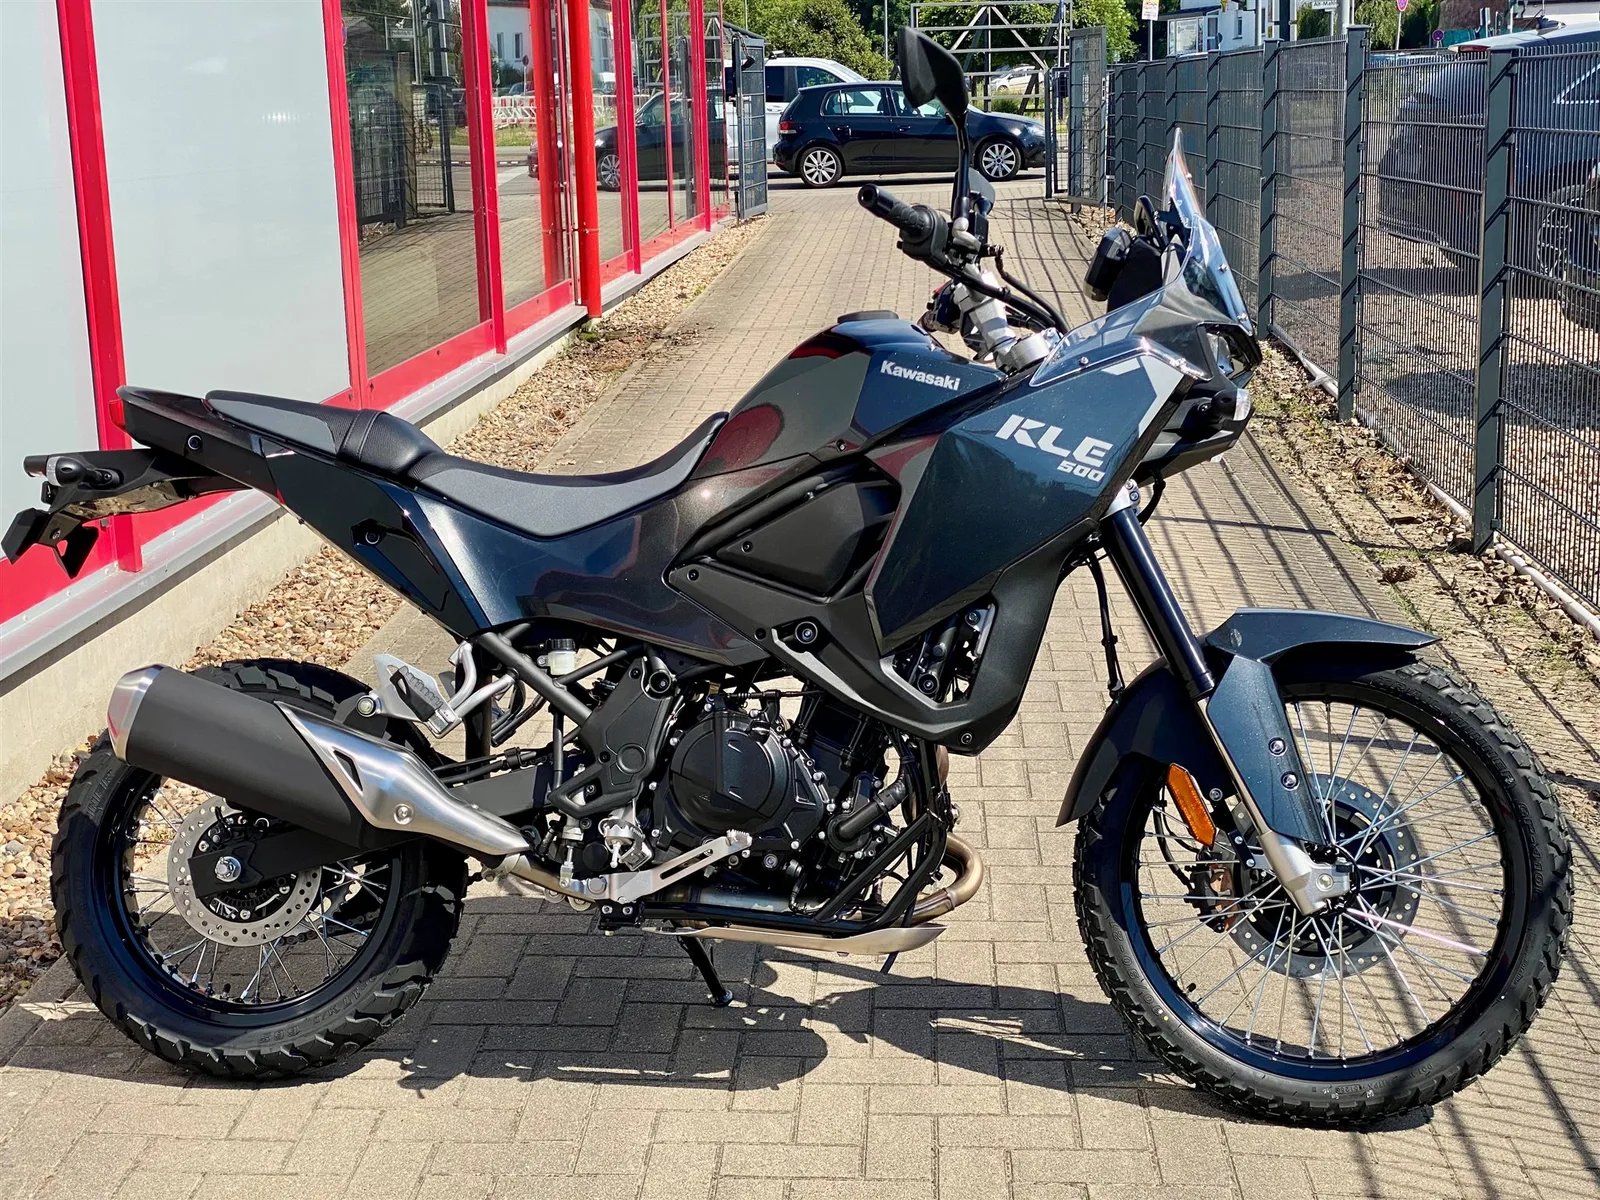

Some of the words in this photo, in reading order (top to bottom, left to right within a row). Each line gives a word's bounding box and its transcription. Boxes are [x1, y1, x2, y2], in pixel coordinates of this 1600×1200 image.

[880, 360, 960, 391] Kawasaki
[995, 414, 1114, 466] KLE
[1057, 461, 1105, 482] 500
